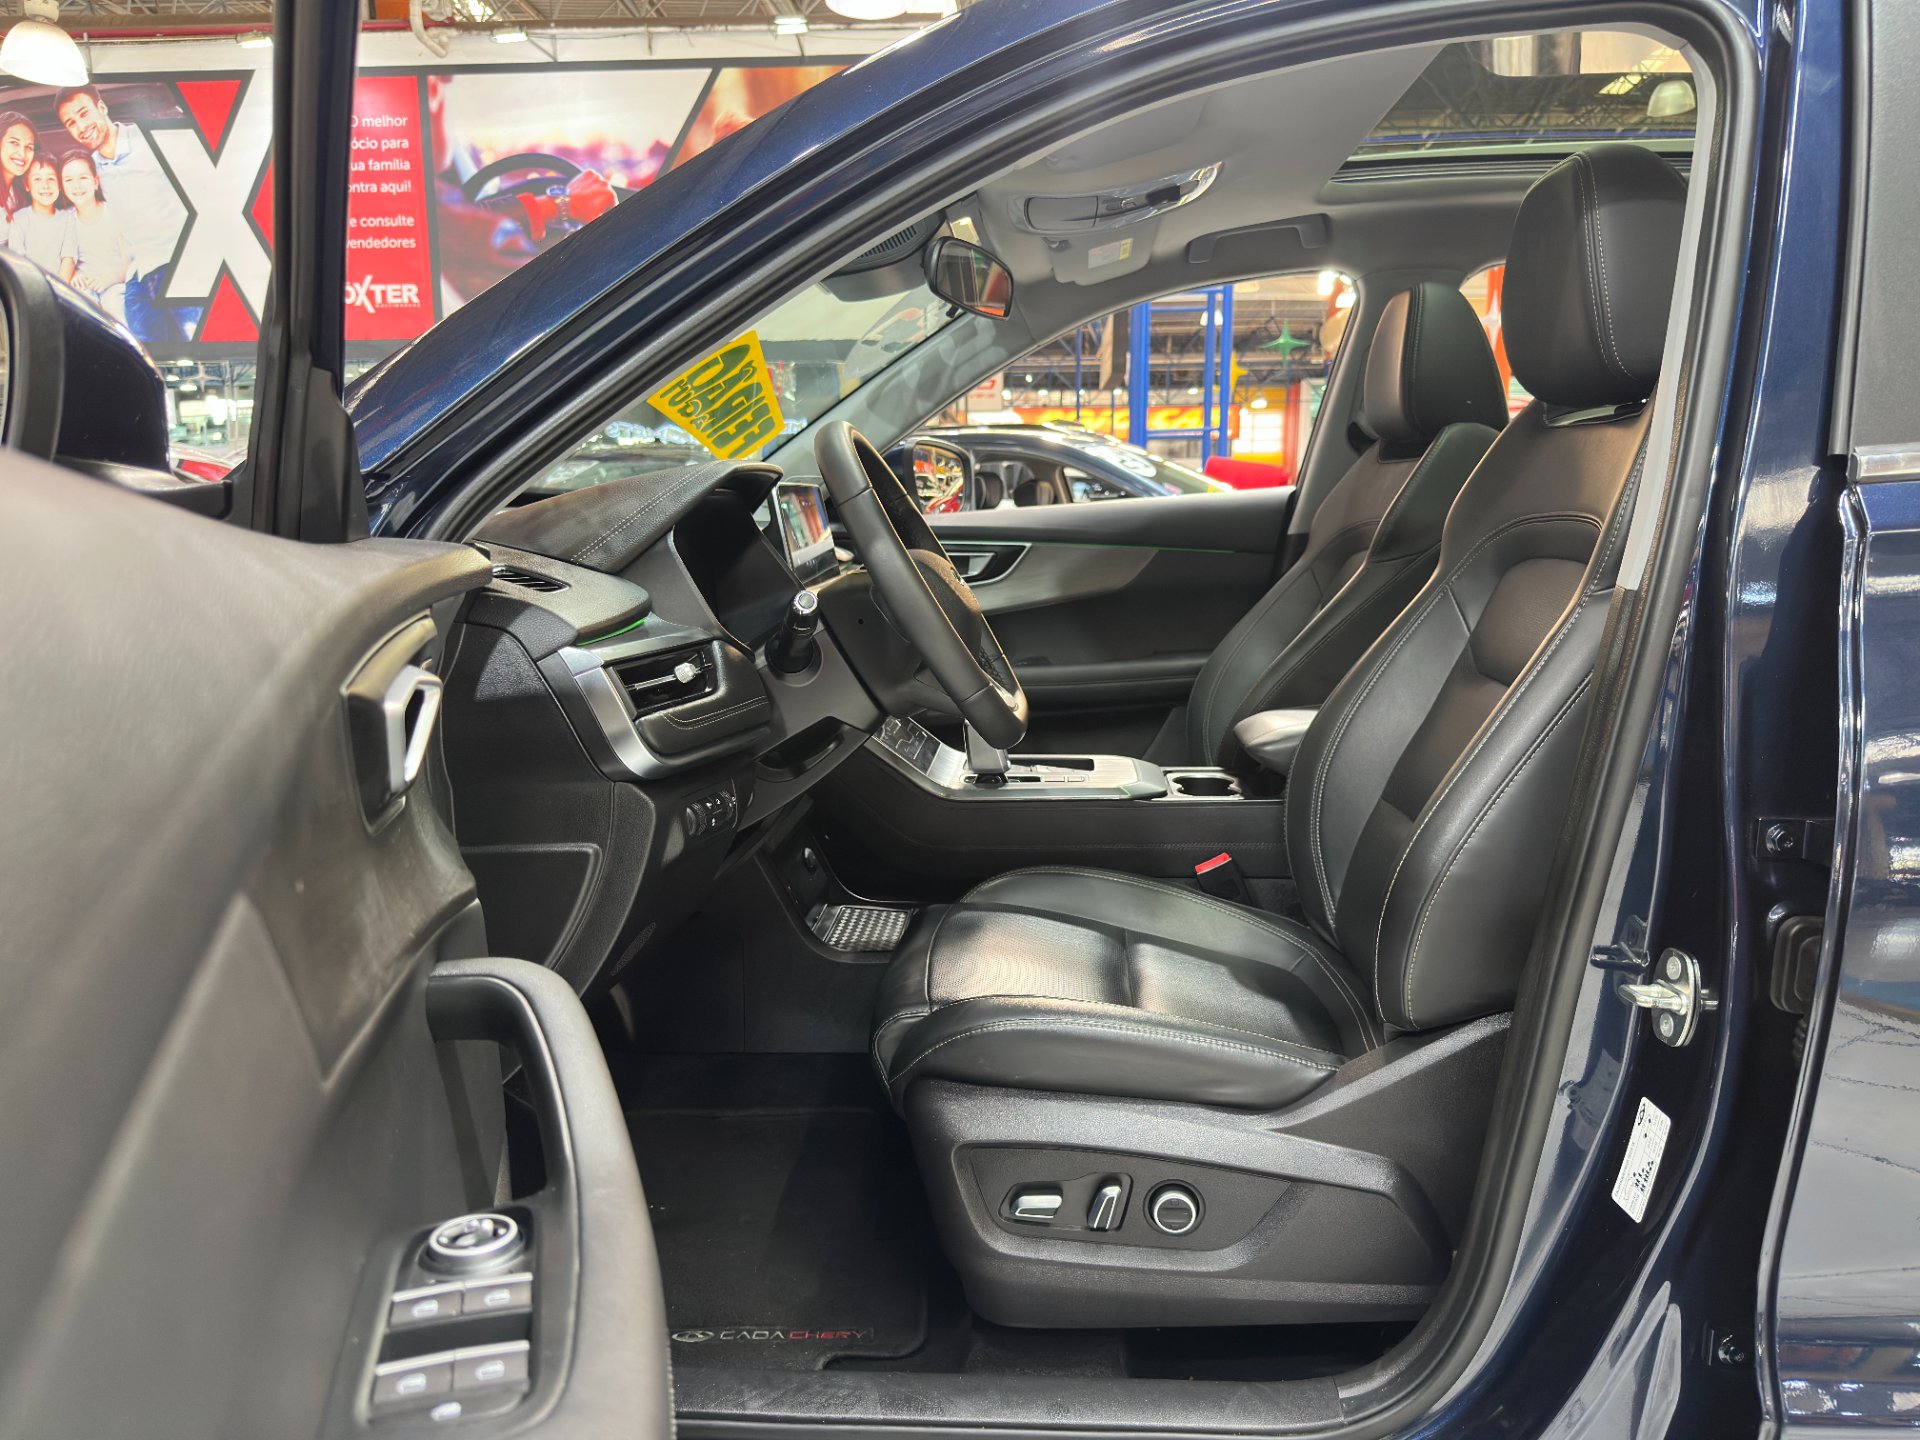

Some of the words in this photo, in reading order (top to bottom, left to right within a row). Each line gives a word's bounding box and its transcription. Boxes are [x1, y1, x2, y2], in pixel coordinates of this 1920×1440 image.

[362, 115, 408, 127] melhor
[351, 138, 377, 149] ócio
[381, 139, 409, 152] para
[349, 162, 366, 171] ua
[368, 158, 411, 171] família
[380, 180, 412, 195] aqui!
[360, 214, 414, 227] consulte
[345, 274, 420, 314] OXTER
